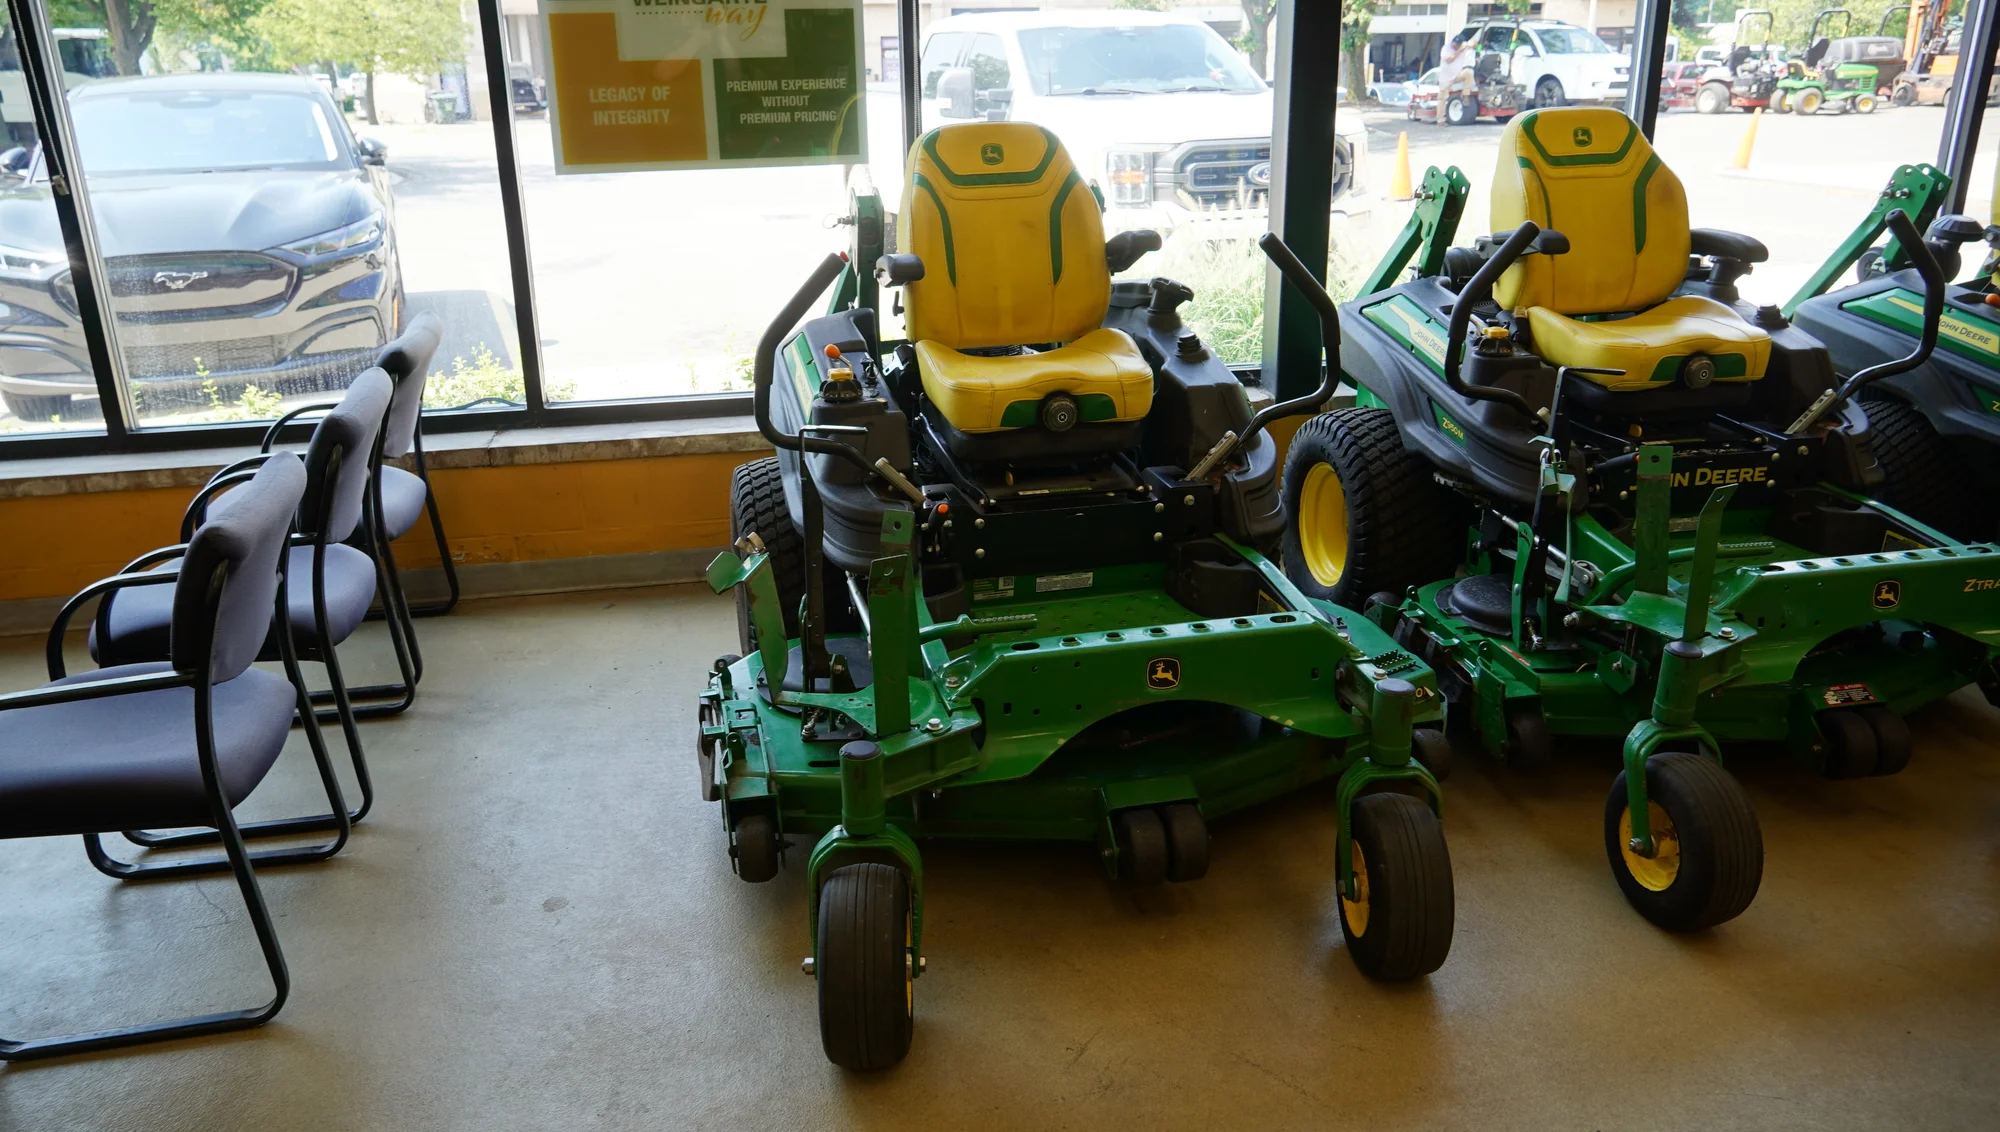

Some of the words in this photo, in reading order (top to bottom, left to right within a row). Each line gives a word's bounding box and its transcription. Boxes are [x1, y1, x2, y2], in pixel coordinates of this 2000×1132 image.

[704, 4, 768, 41] way
[726, 80, 778, 92] PREMIUM
[781, 78, 847, 91] EXPERIENCE
[589, 86, 647, 103] LEGACY
[652, 86, 671, 101] OF
[762, 95, 810, 107] WITHOUT
[593, 108, 670, 125] INTEGRITY
[740, 112, 791, 124] PREMIUM
[794, 110, 837, 122] PRICING
[1414, 329, 1430, 344] JOHN
[1959, 327, 1991, 345] DEERE
[1695, 467, 1768, 486] DEERE
